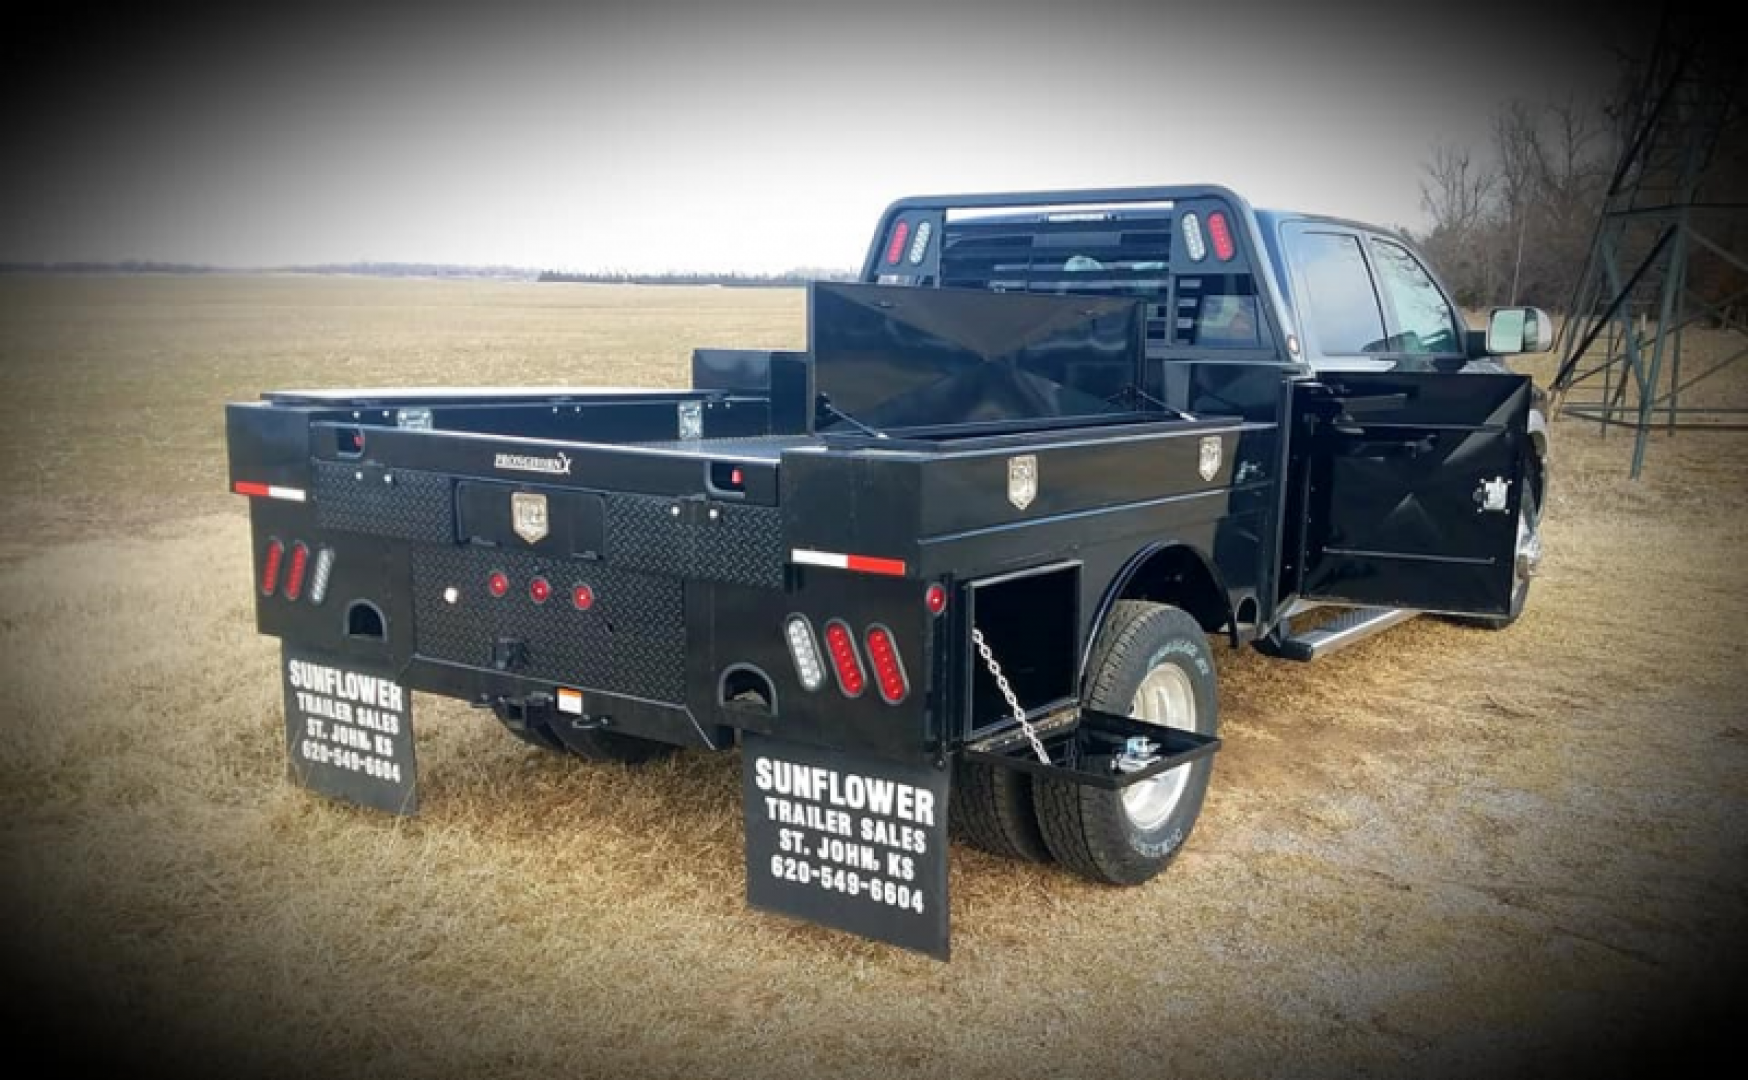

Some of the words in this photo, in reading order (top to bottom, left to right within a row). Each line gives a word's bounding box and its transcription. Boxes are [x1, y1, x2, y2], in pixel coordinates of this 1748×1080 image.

[289, 658, 403, 713] SUNFLOWER
[755, 756, 935, 827] SUNFLOWER
[765, 796, 852, 837] TRAILER
[861, 817, 927, 854] SALES
[779, 828, 811, 856] ST.
[887, 852, 915, 882] KS
[771, 854, 925, 915] 620-549-6604
